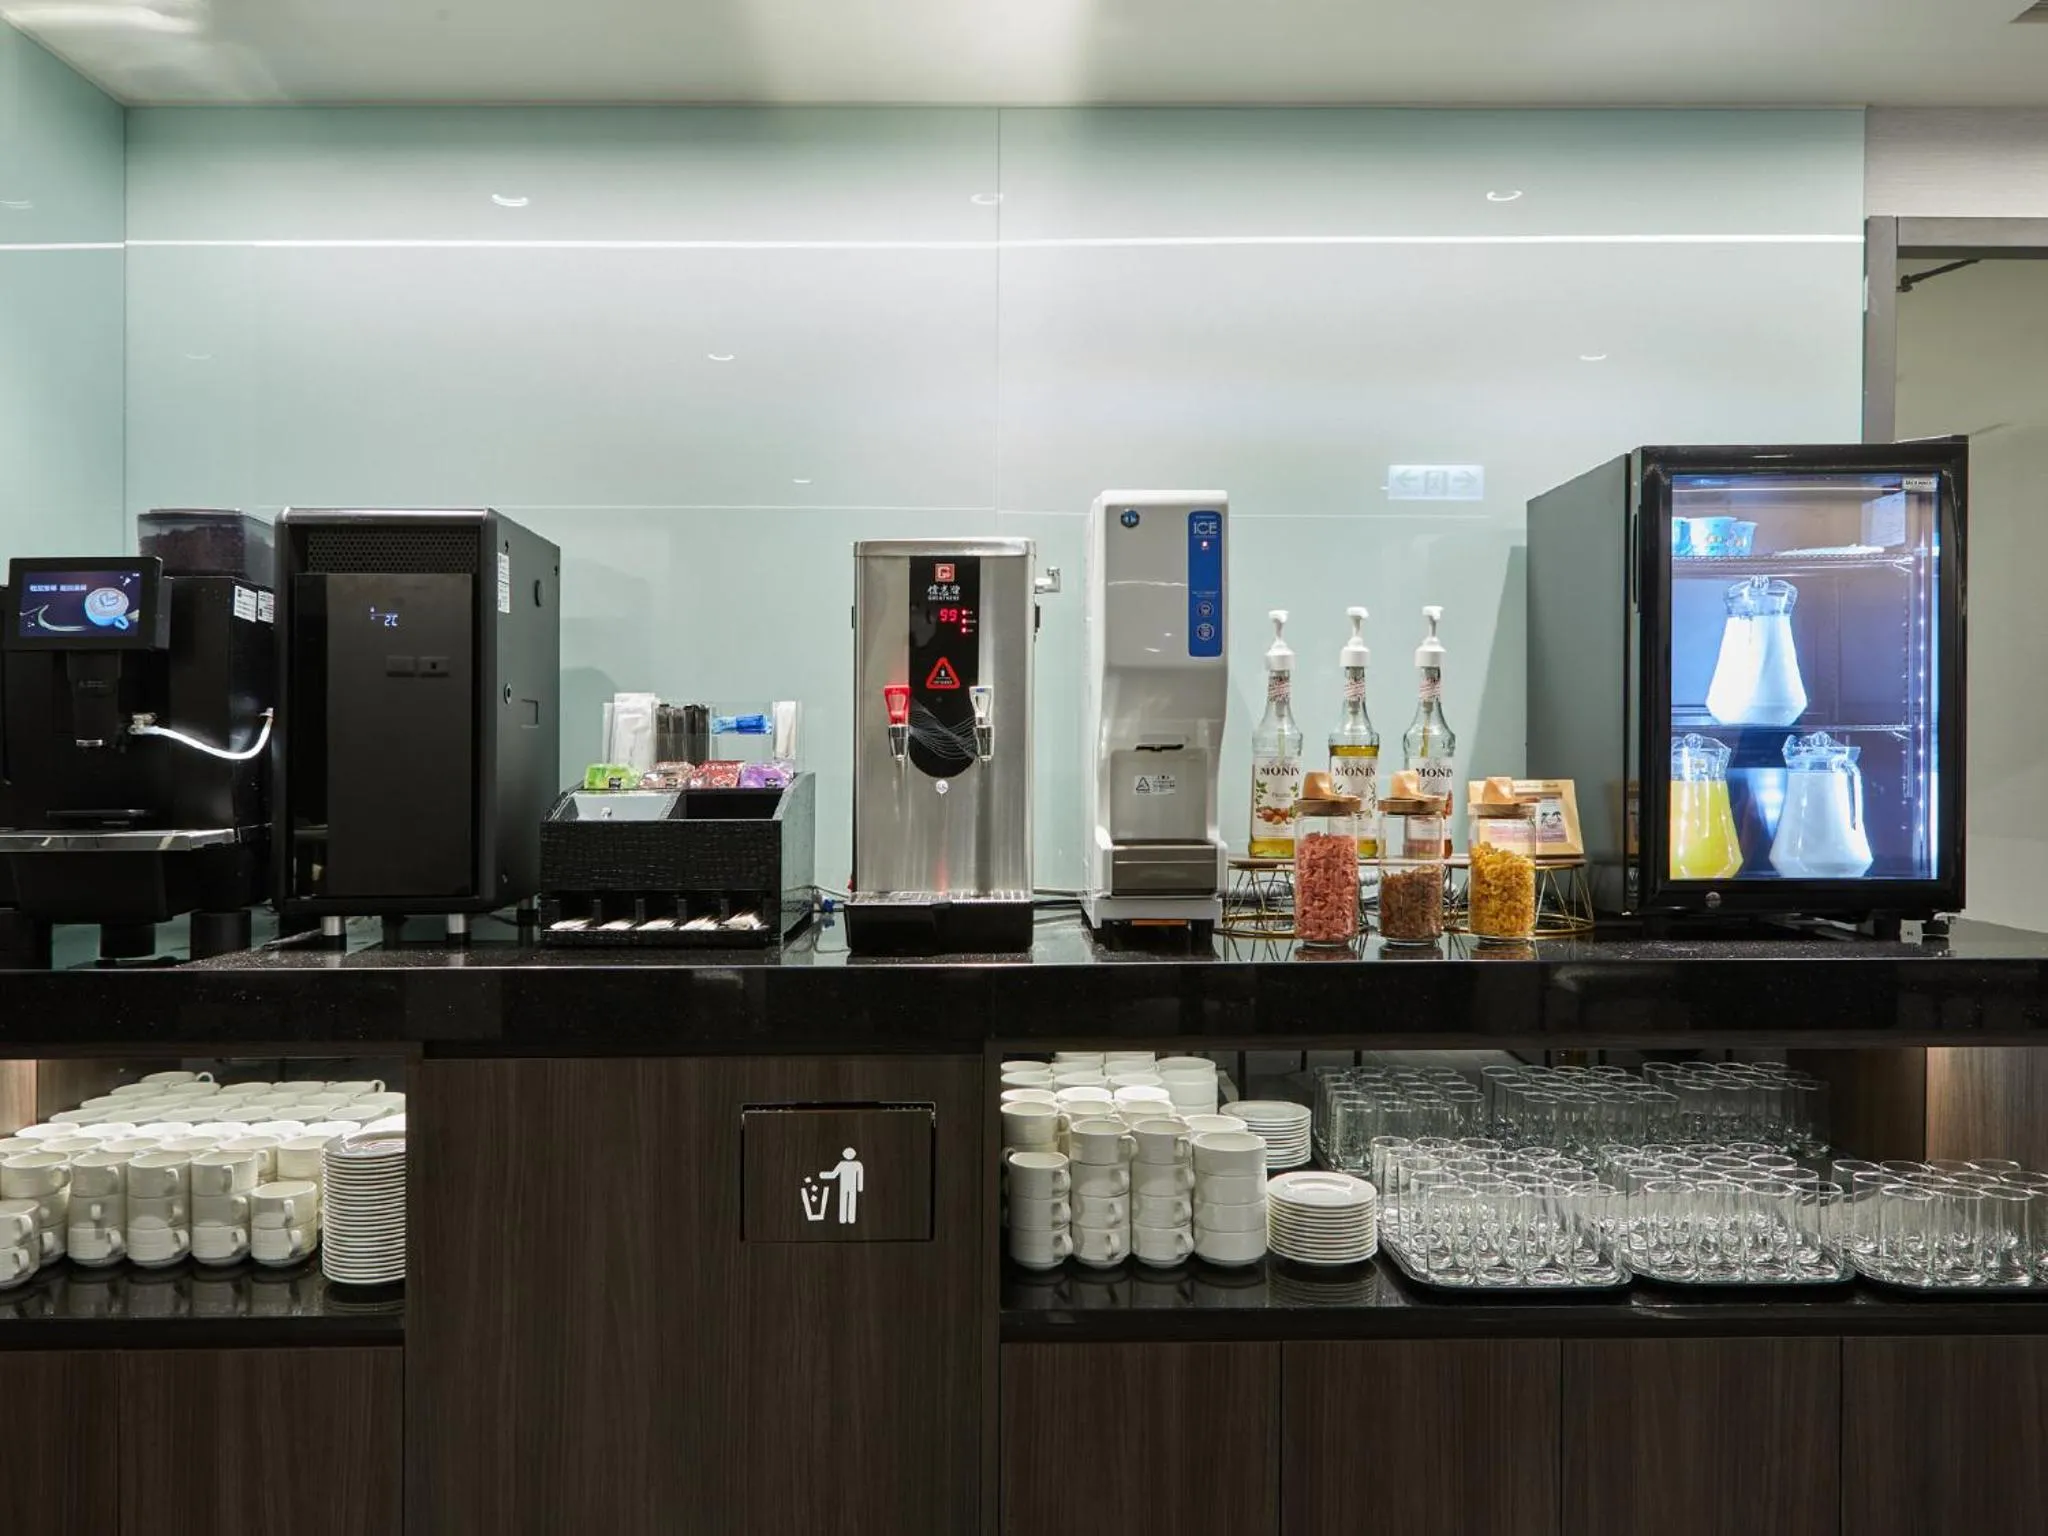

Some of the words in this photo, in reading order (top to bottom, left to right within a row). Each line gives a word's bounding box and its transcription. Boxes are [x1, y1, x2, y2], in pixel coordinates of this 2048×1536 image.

[1193, 522, 1217, 535] ICE
[940, 608, 957, 621] 99
[1335, 767, 1376, 777] MONIN
